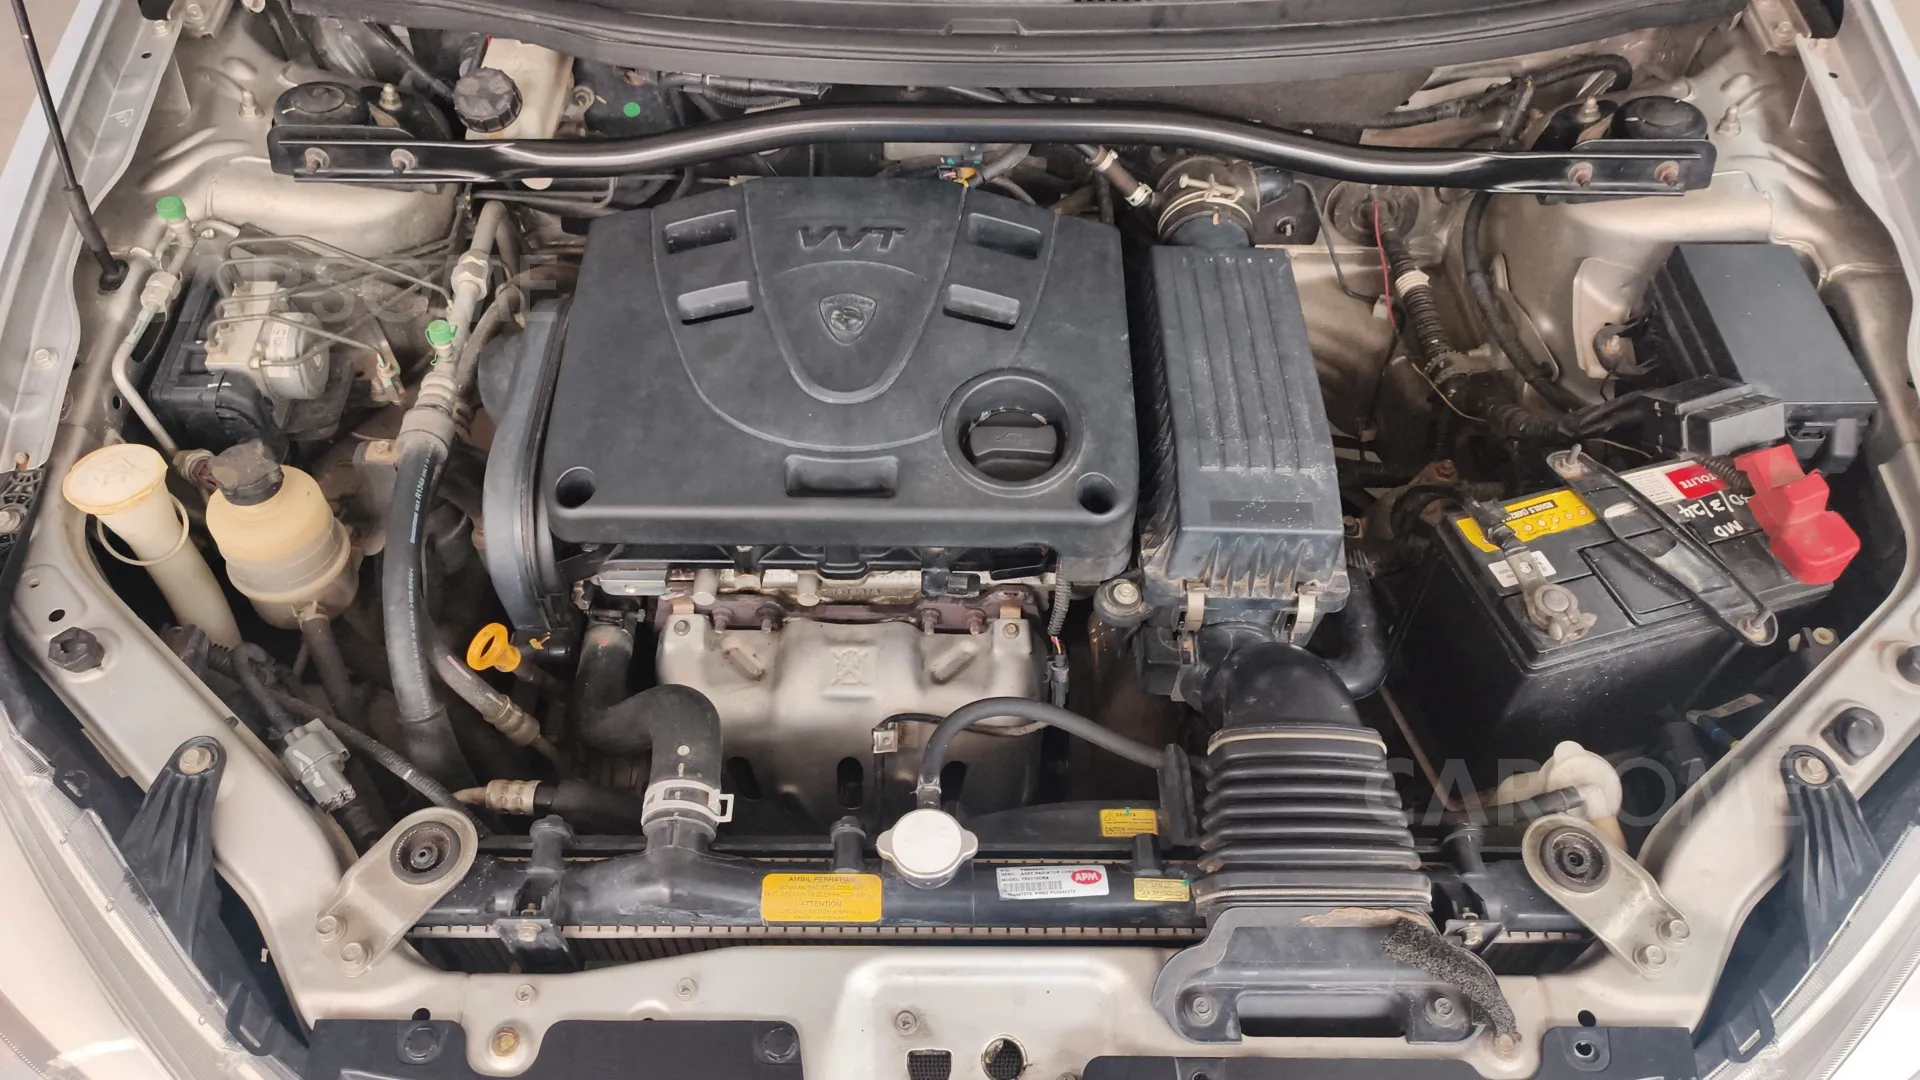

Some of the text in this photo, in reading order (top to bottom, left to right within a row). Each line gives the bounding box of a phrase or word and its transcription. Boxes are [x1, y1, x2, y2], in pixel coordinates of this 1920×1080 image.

[797, 225, 906, 252] VVT
[1713, 519, 1744, 537] MD
[1075, 872, 1098, 881] APM
